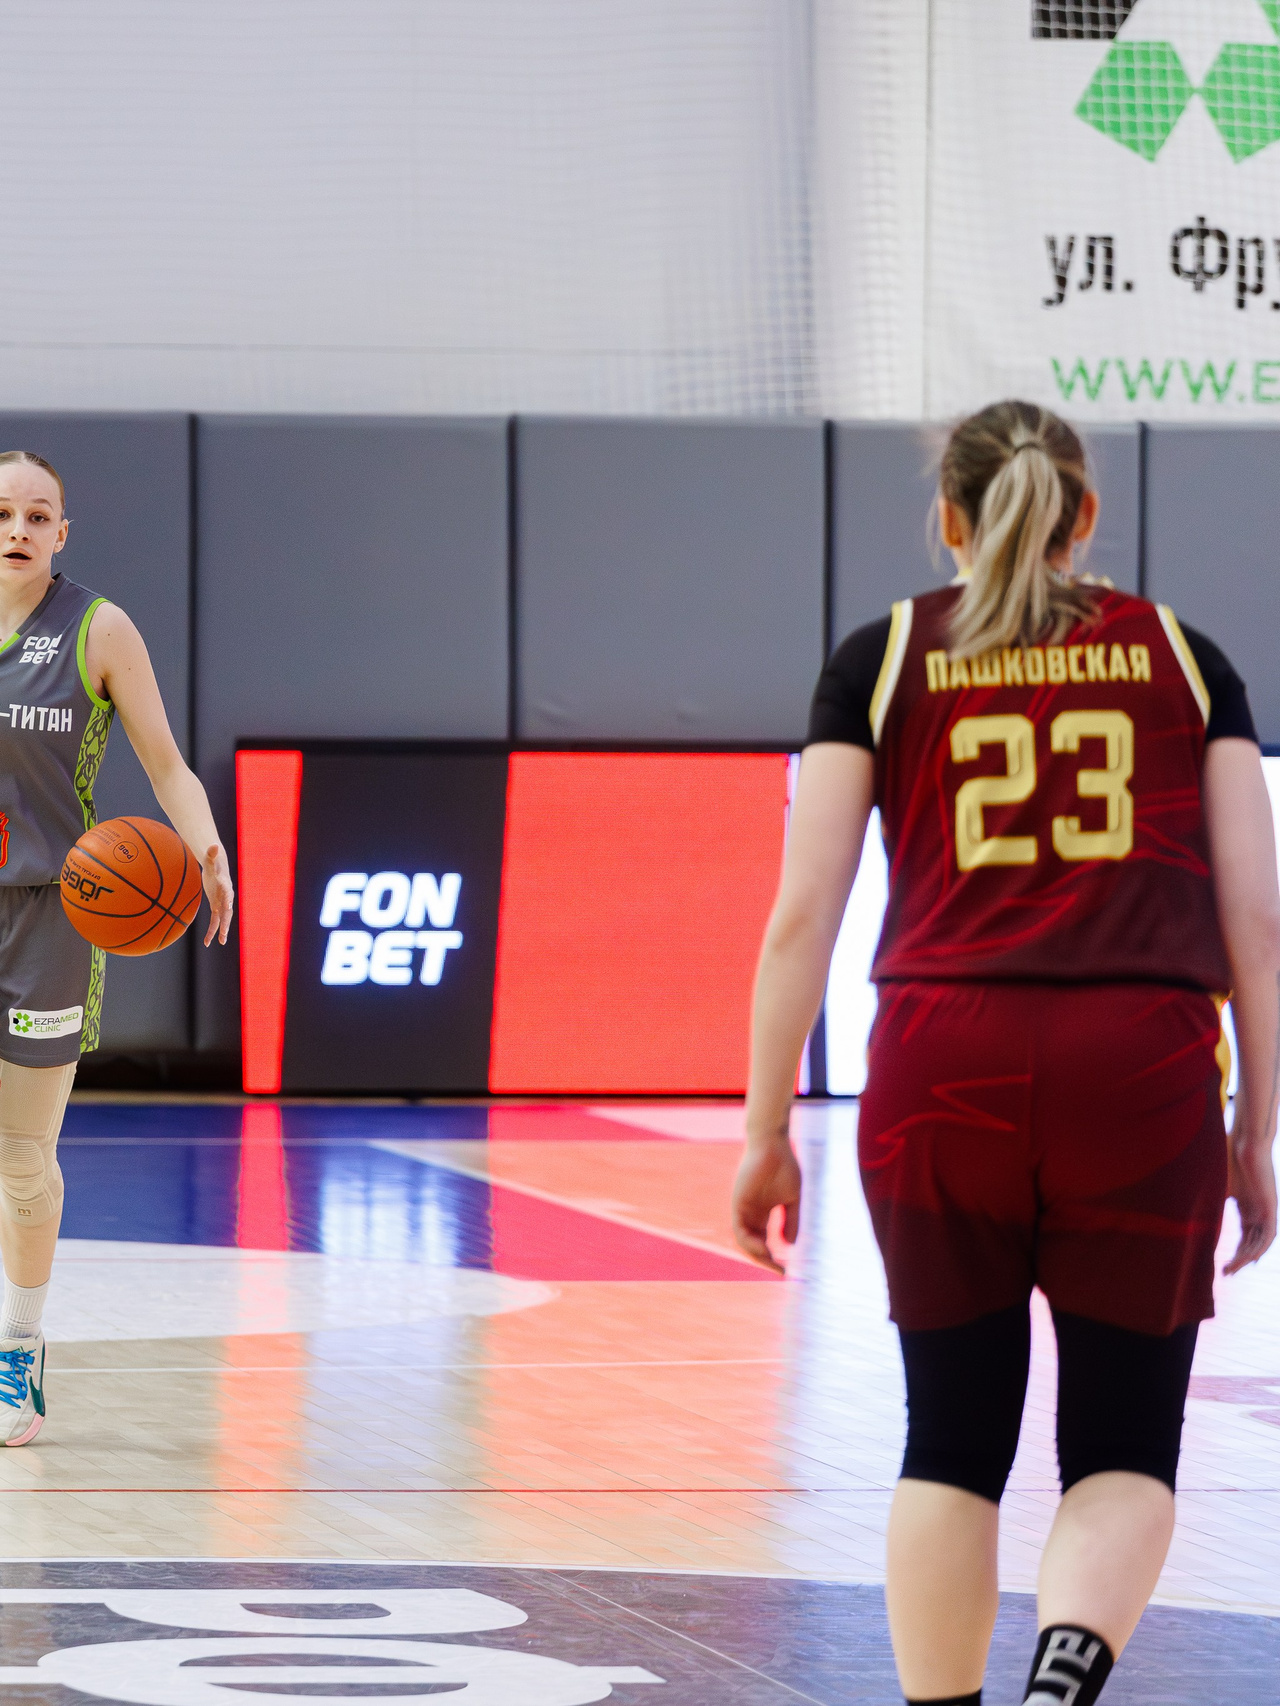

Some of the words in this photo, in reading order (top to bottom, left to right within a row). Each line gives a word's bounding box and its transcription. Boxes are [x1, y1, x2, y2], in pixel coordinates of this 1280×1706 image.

[1042, 234, 1134, 308] ул.
[19, 649, 59, 664] BET
[925, 644, 1151, 692] ПАШКОВСКАЯ
[950, 709, 1134, 872] 23
[320, 872, 462, 928] FON
[320, 931, 463, 985] BET
[34, 1013, 79, 1025] EZRAMED
[34, 1025, 61, 1033] CLINIC
